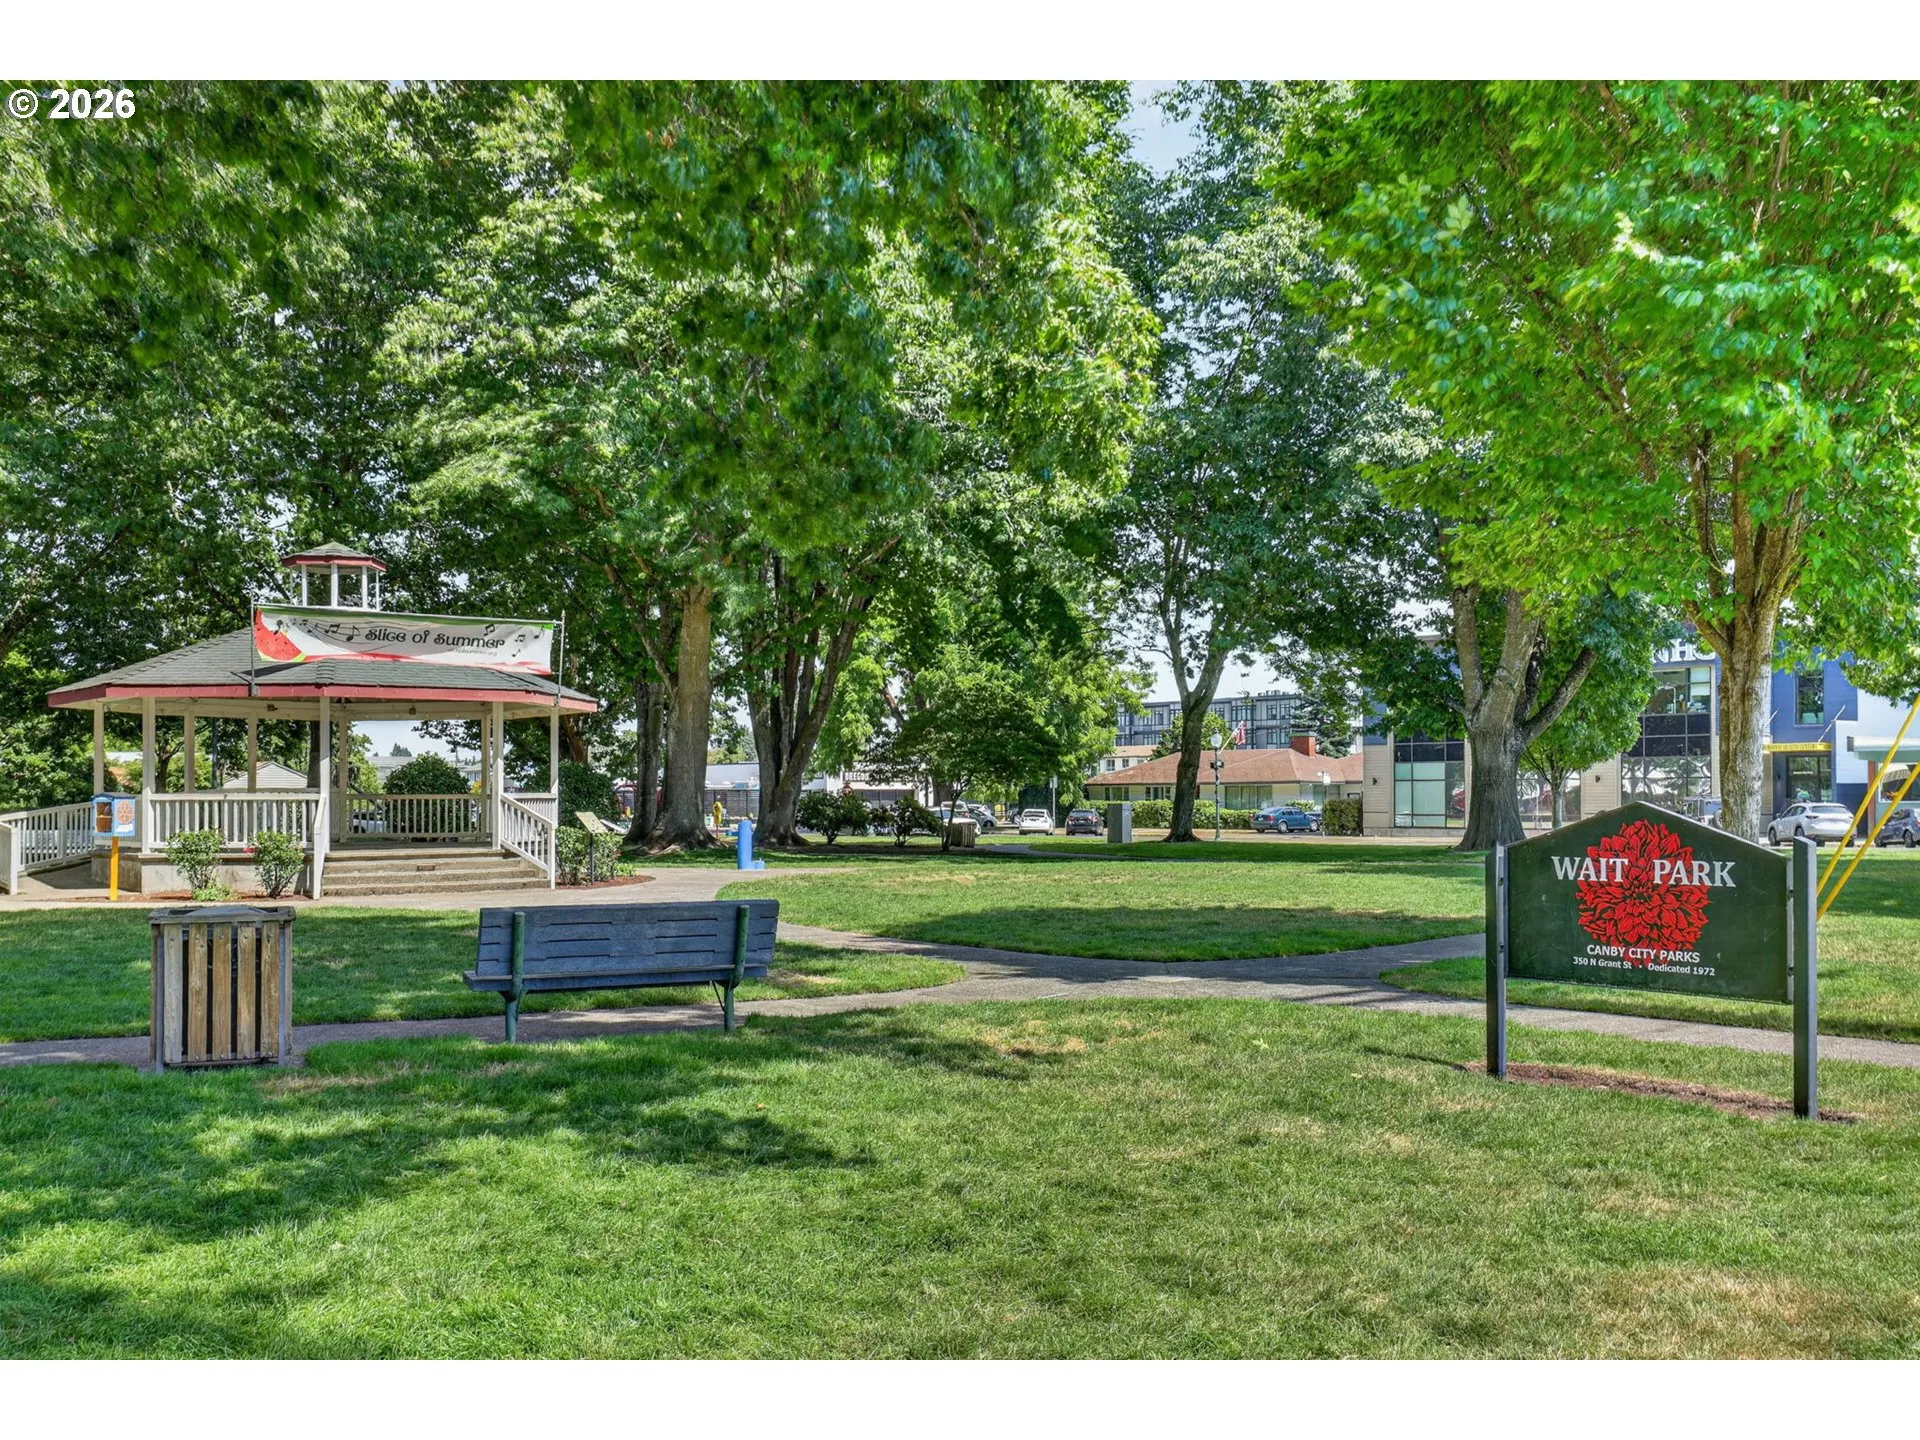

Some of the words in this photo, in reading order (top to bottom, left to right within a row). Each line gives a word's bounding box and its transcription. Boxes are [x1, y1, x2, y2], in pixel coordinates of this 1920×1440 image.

[365, 628, 406, 642] Slice
[412, 630, 430, 643] of
[434, 633, 505, 648] Summer
[1551, 856, 1628, 882] WAIT
[1652, 858, 1736, 887] PARK
[1586, 945, 1626, 957] CANBY
[1628, 948, 1656, 959] CITY
[1660, 950, 1700, 963] PARKS
[1573, 956, 1588, 965] 350
[1590, 958, 1596, 966] N
[1598, 959, 1621, 967] Grant
[1623, 960, 1632, 969] St
[1648, 962, 1690, 974] Dedicated
[1693, 966, 1715, 976] 1972
